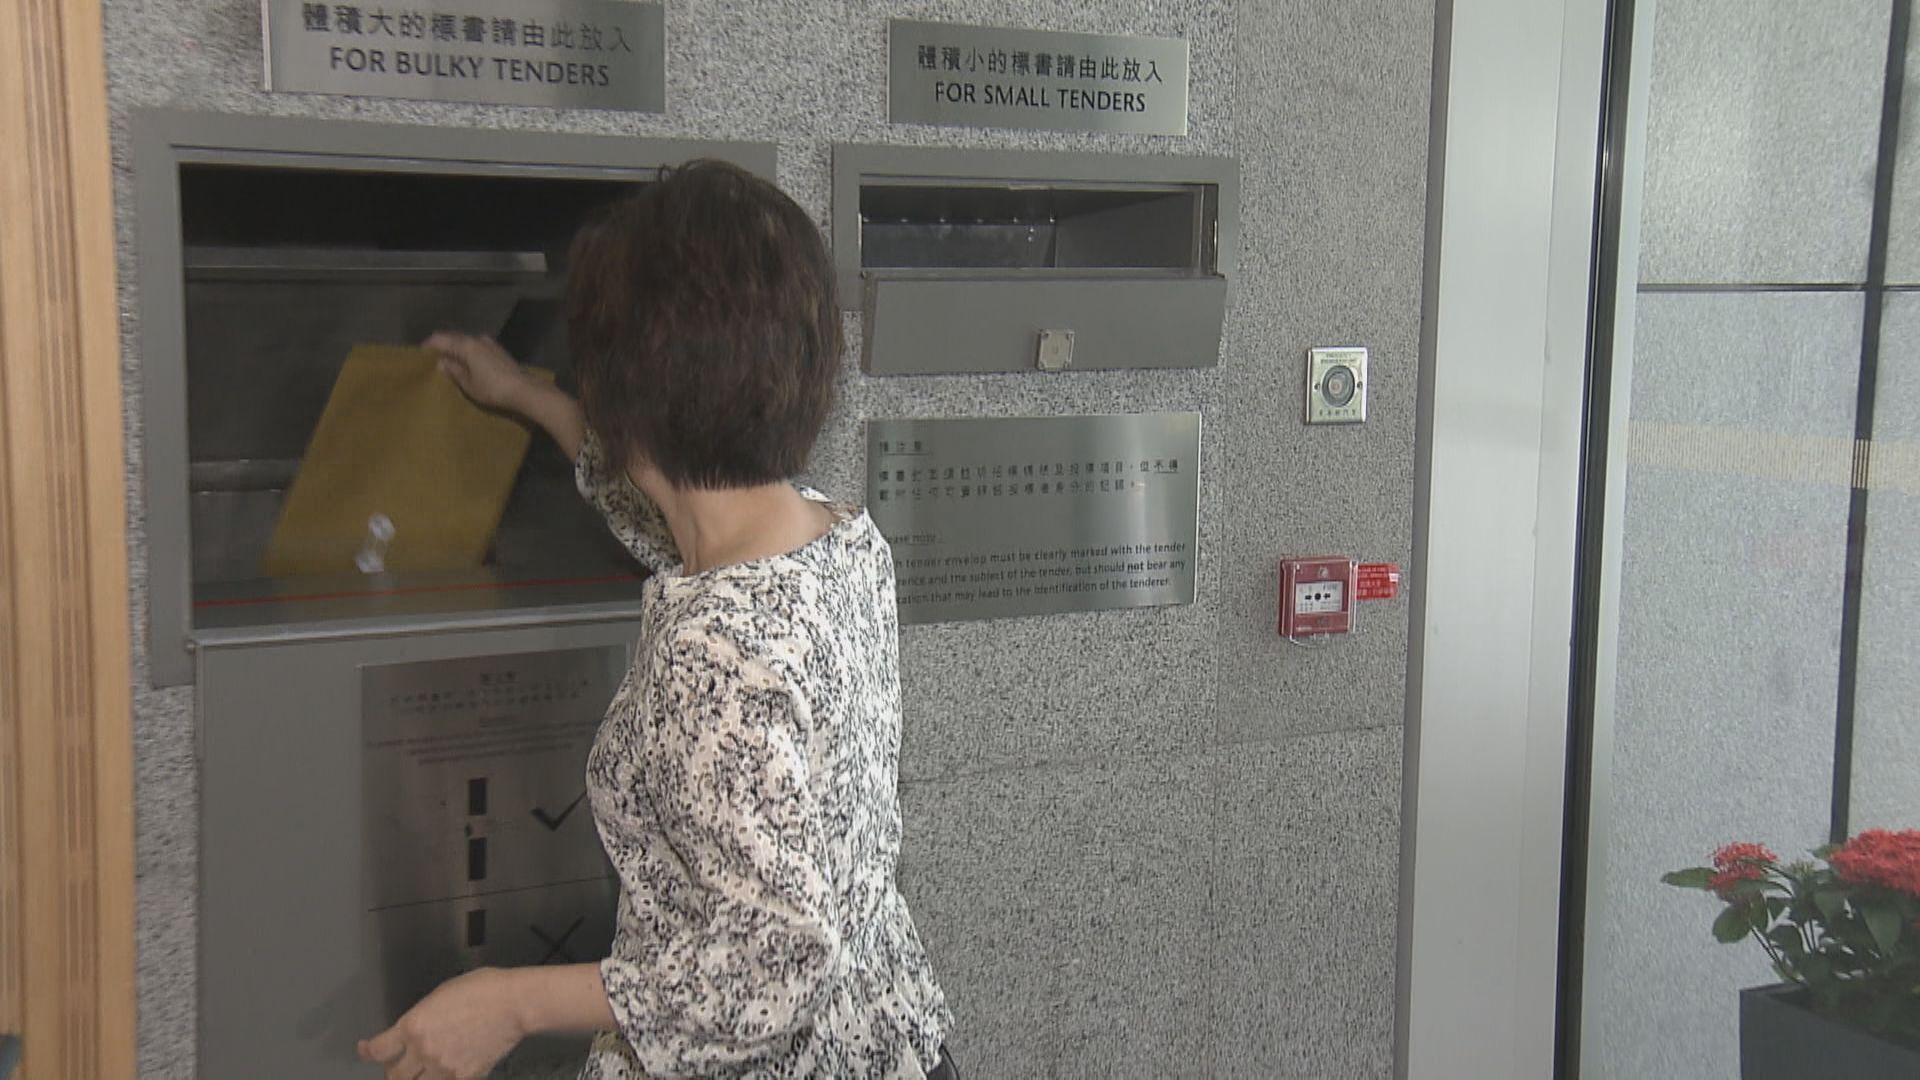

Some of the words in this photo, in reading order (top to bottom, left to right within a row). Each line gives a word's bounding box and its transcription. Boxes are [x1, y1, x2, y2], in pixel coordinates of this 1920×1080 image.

[302, 3, 633, 53] 體積大的標書請由此放入
[330, 46, 387, 74] FOR
[396, 50, 485, 80] BULKY
[493, 57, 610, 87] TENDERS
[917, 44, 1163, 84] 體積小的標書請由此放入
[935, 80, 976, 104] FOR
[983, 85, 1051, 109] SMALL
[1056, 89, 1146, 113] TENDERS
[990, 551, 1016, 564] must
[1019, 549, 1030, 561] be
[1035, 545, 1067, 562] clearly
[1071, 545, 1108, 559] marked
[1110, 544, 1133, 556] with
[1135, 542, 1151, 554] the
[1154, 541, 1186, 552] tender
[928, 573, 947, 585] and
[970, 570, 1004, 585] subject
[1007, 568, 1018, 580] of
[1021, 567, 1036, 579] the
[1075, 564, 1092, 576] but
[1094, 561, 1125, 574] should
[1127, 562, 1144, 572] not
[1146, 558, 1167, 570] bear
[1170, 559, 1186, 571] any
[955, 590, 975, 603] may
[978, 586, 1000, 599] lead
[1002, 586, 1013, 597] to
[1016, 584, 1031, 597] the
[1034, 578, 1097, 594] identification
[1099, 577, 1109, 591] of
[1111, 577, 1128, 590] the
